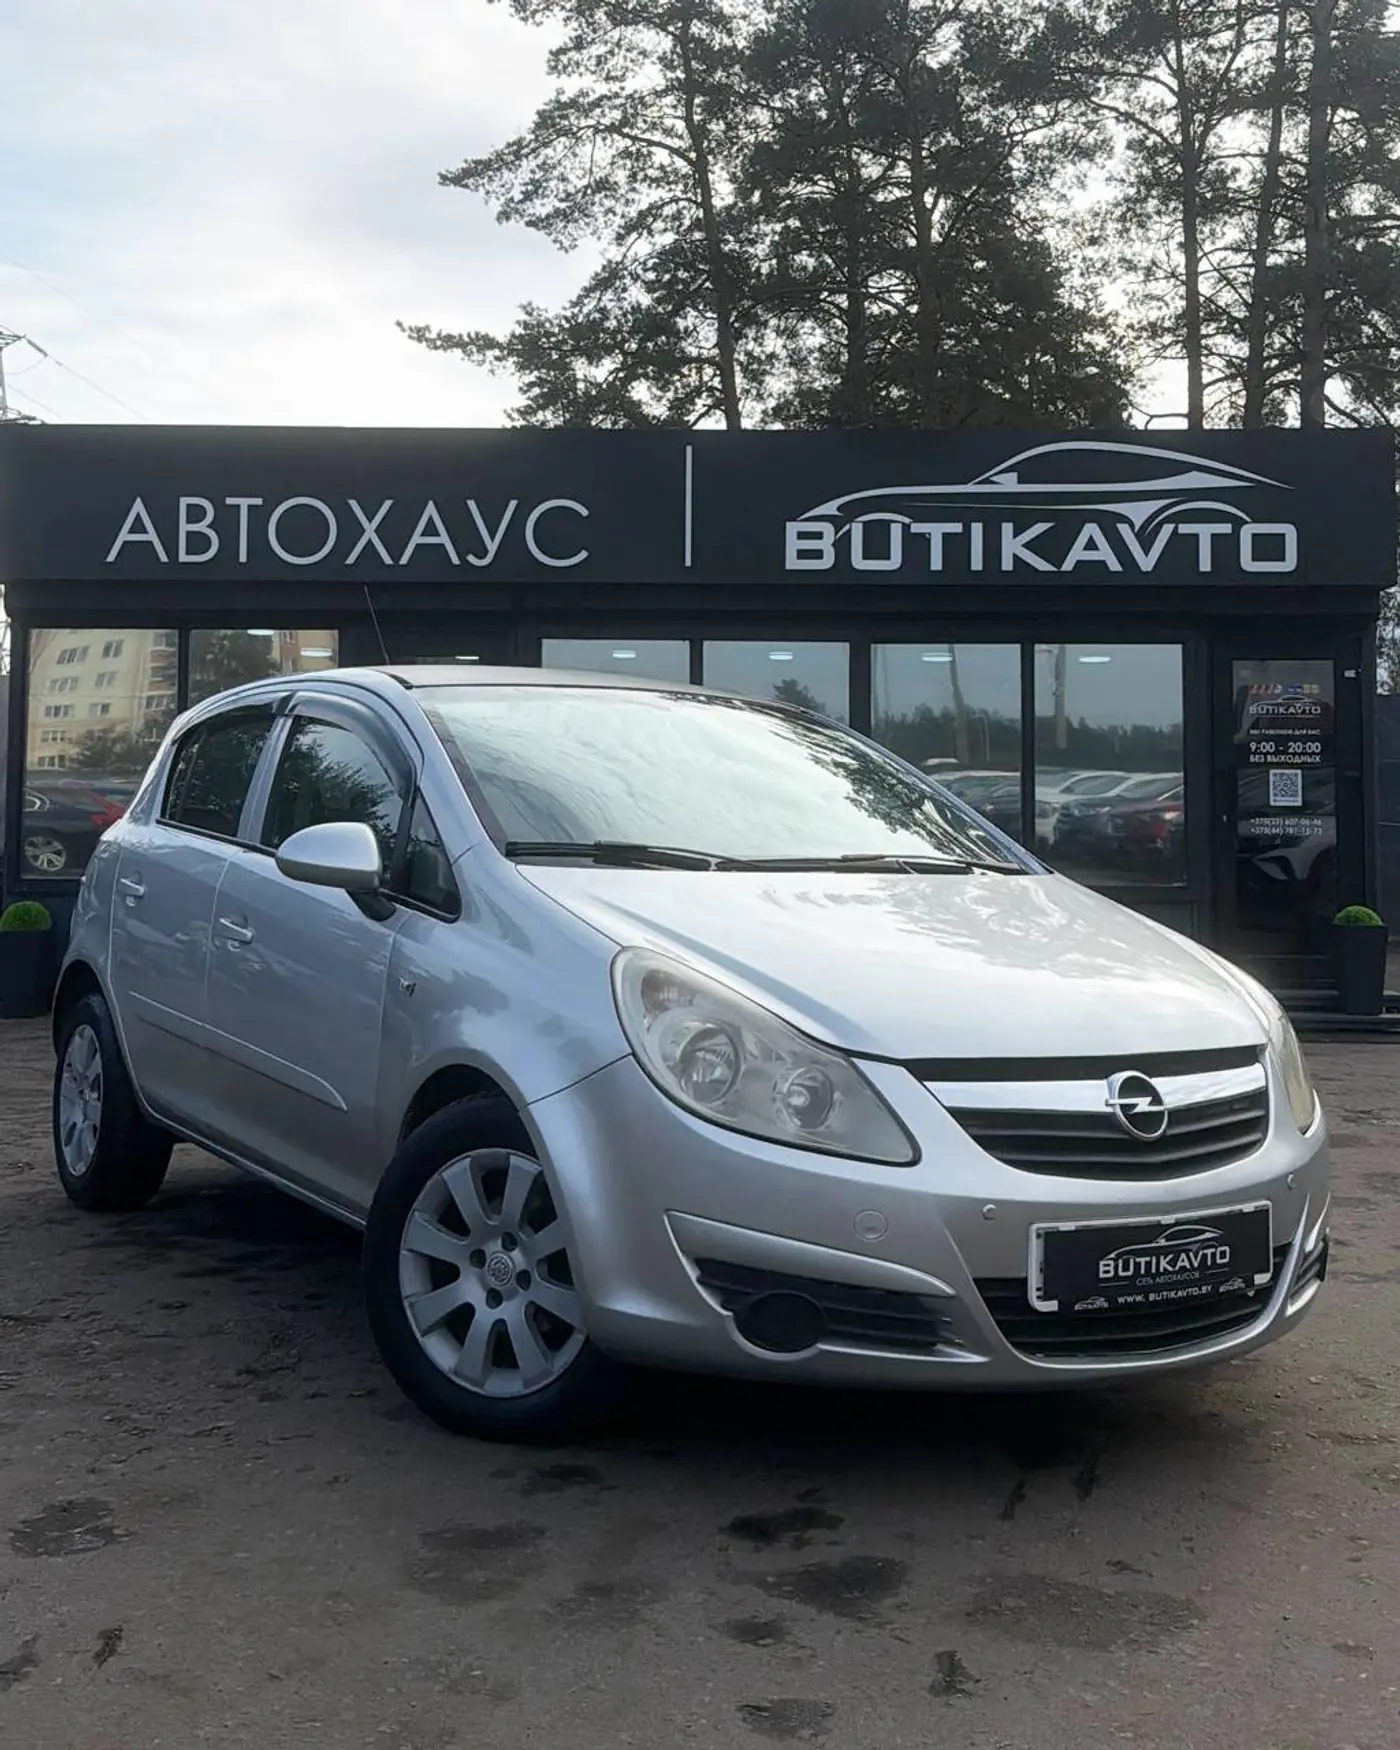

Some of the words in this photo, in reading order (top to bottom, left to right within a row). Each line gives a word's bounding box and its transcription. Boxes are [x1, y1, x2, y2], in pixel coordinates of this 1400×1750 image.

[105, 496, 590, 568] АВТОХАУС
[784, 520, 1298, 573] BUTIKAVTO
[1249, 705, 1321, 714] BUTIKAVTO
[1249, 742, 1275, 753] 9:00
[1287, 742, 1321, 753] 20:00
[1249, 754, 1265, 763] БЕЗ
[1266, 754, 1321, 763] ВЫХОДНЫХ
[1099, 1246, 1230, 1278] BUTIKAVTO
